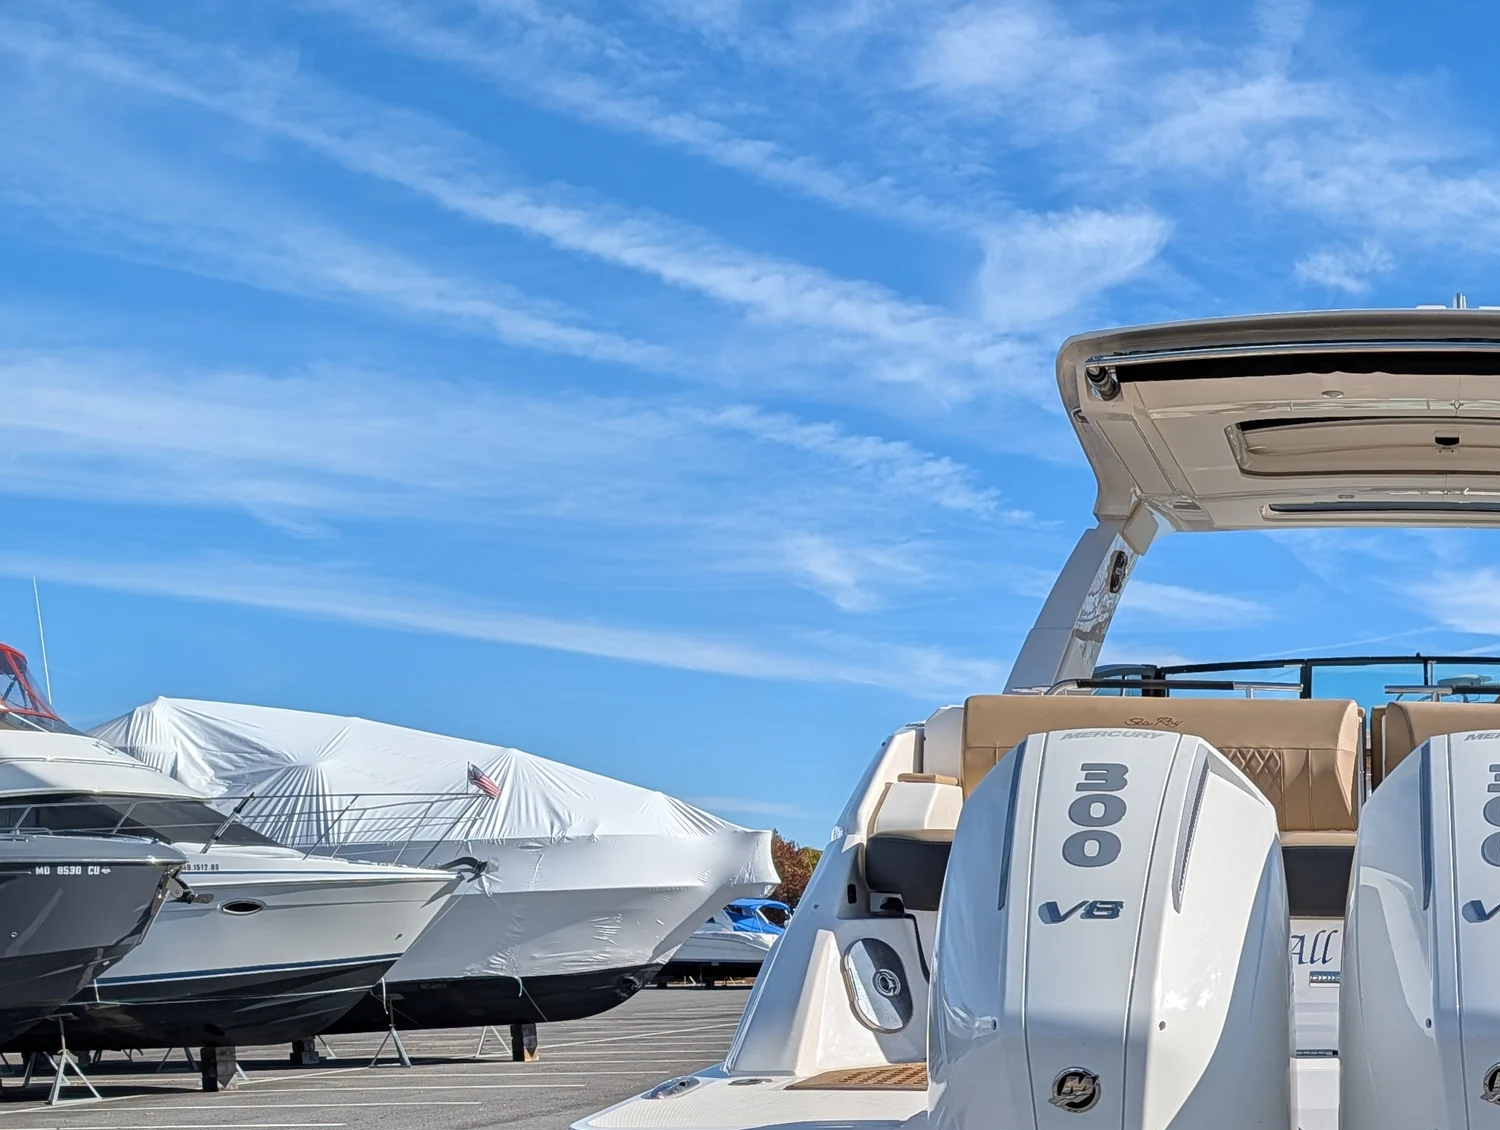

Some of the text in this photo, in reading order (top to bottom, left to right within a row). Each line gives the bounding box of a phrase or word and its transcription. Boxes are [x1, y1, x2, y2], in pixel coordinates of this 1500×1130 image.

[1060, 731, 1166, 741] MERCURY
[1061, 762, 1129, 868] 300
[35, 865, 100, 875] MD 8530 CU
[1038, 900, 1125, 924] V8
